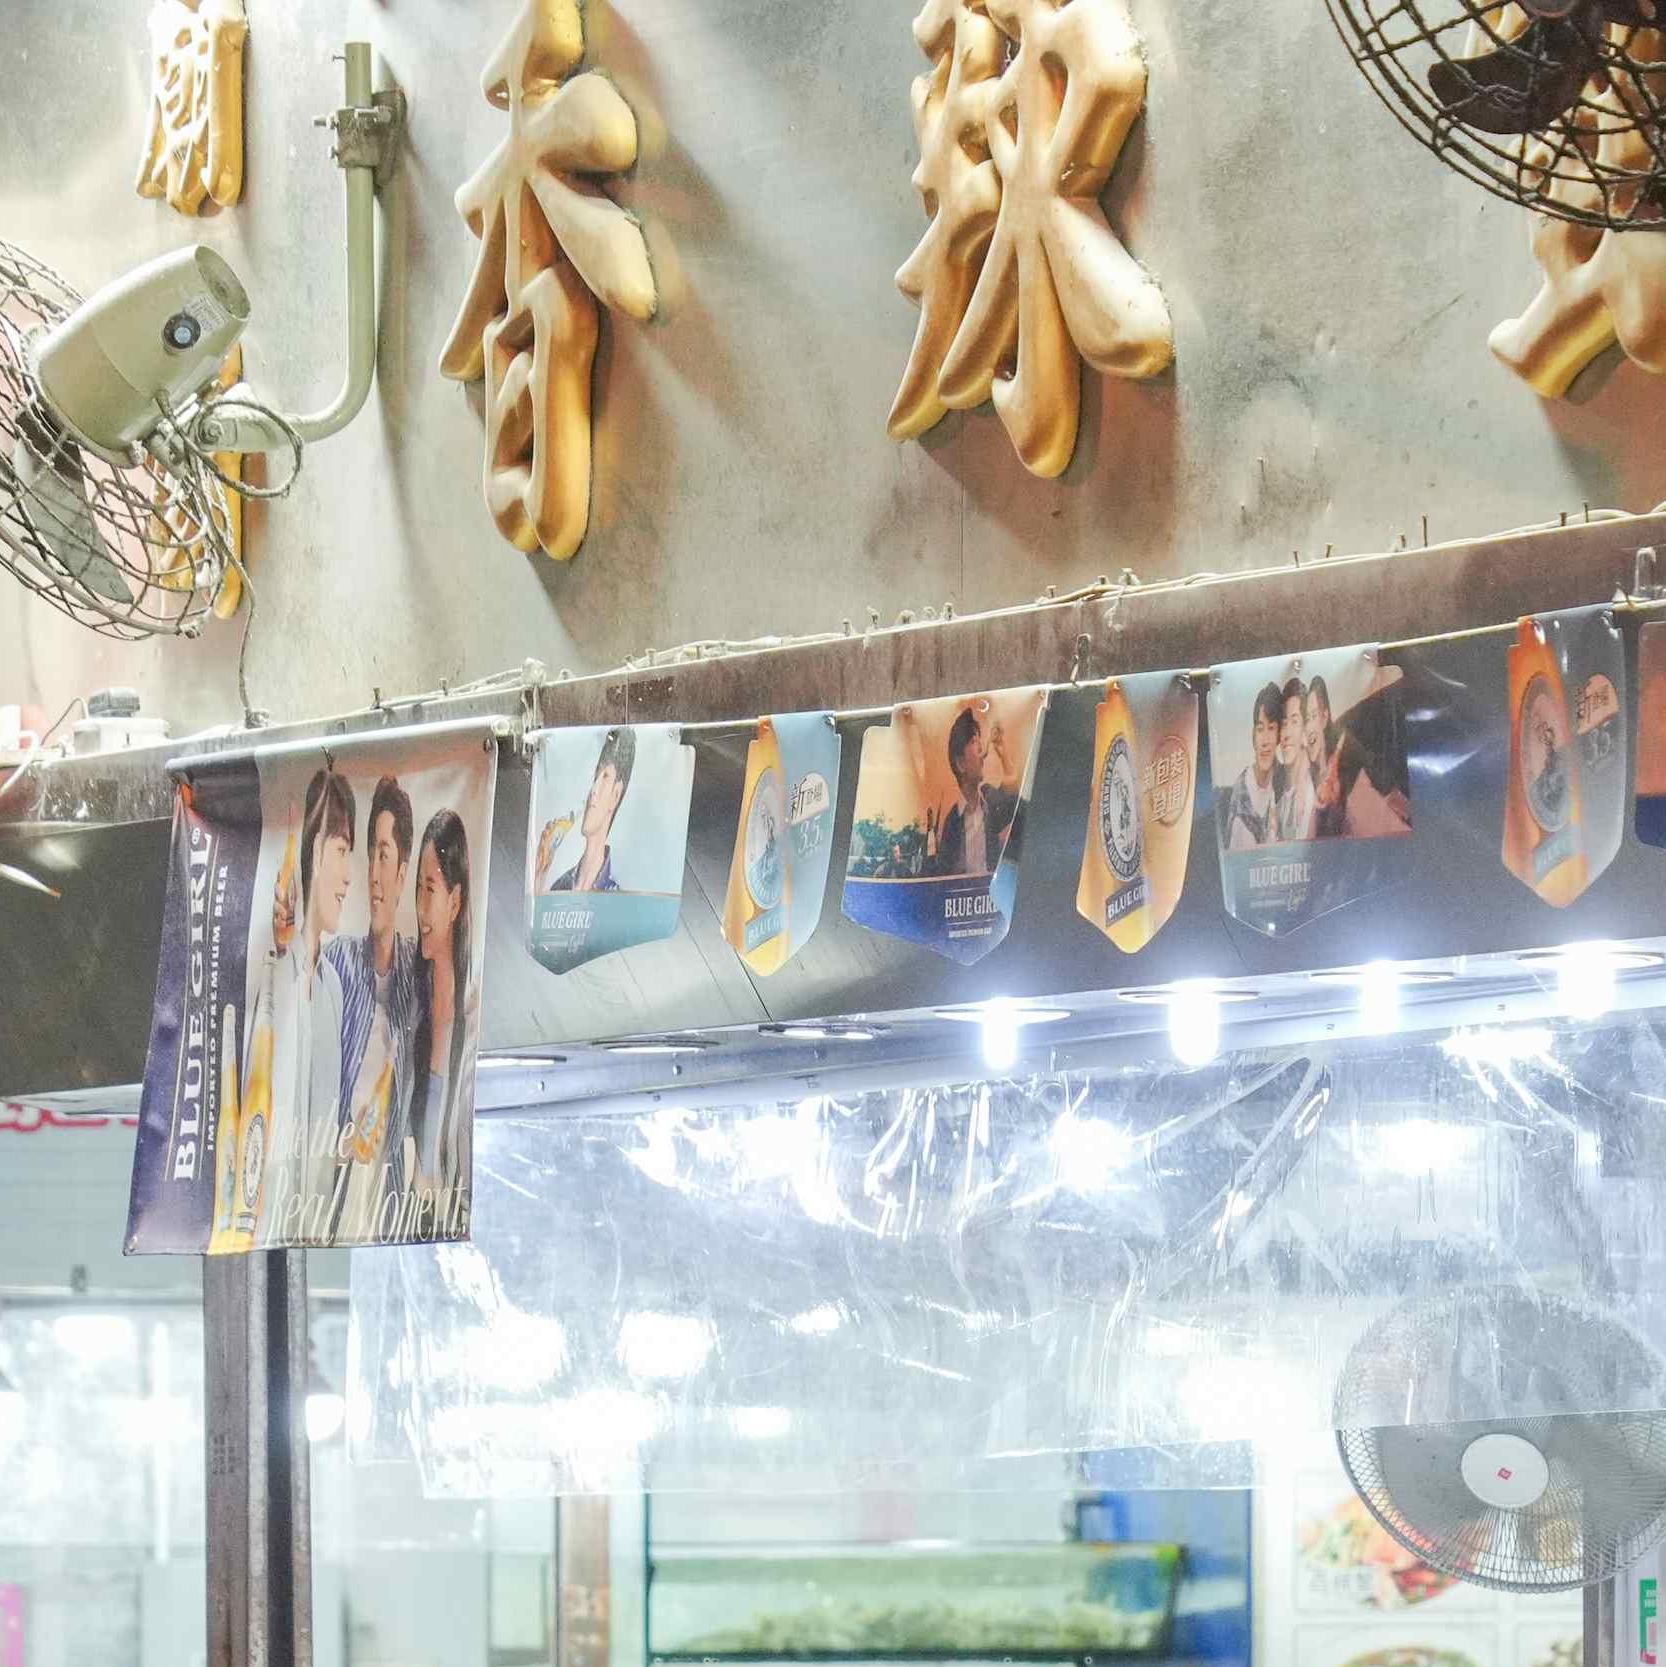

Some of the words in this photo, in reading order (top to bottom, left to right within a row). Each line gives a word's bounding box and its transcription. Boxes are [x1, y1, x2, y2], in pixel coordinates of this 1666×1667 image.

[215, 864, 228, 918] BEER
[944, 897, 972, 918] BLUE
[174, 1011, 203, 1181] BLUE
[190, 832, 212, 999] GIRL
[210, 924, 221, 1029] PREMIUM
[206, 1037, 217, 1151] IMPORTED
